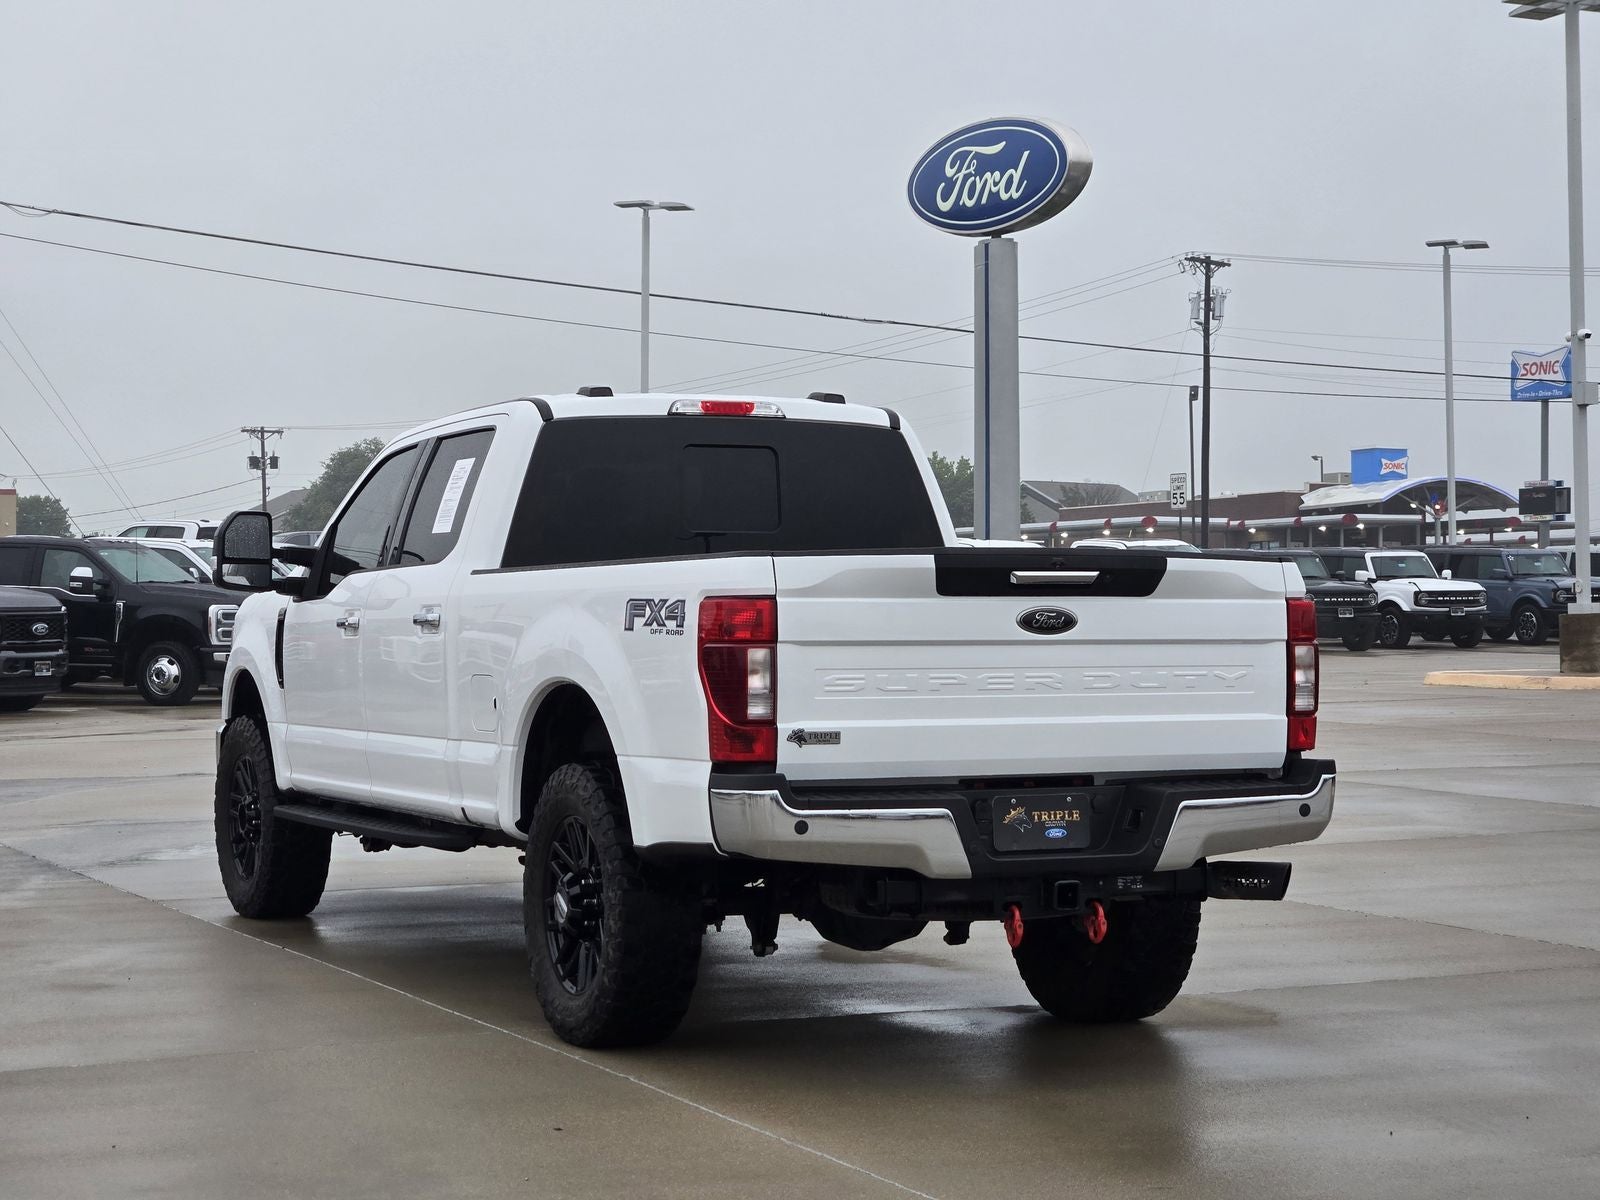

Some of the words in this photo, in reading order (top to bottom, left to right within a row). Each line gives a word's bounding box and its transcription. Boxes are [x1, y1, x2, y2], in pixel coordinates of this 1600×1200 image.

[936, 140, 1030, 212] Ford
[1520, 360, 1560, 377] SONIC
[1383, 462, 1405, 470] SONIC
[1172, 492, 1185, 505] 55
[624, 598, 686, 632] FX4
[1032, 611, 1065, 629] Ford
[823, 672, 1064, 692] SUPER
[1082, 670, 1248, 690] DUTY
[808, 732, 840, 740] TRIPLE
[1032, 810, 1081, 822] TRIPLE
[1049, 829, 1063, 837] Ford
